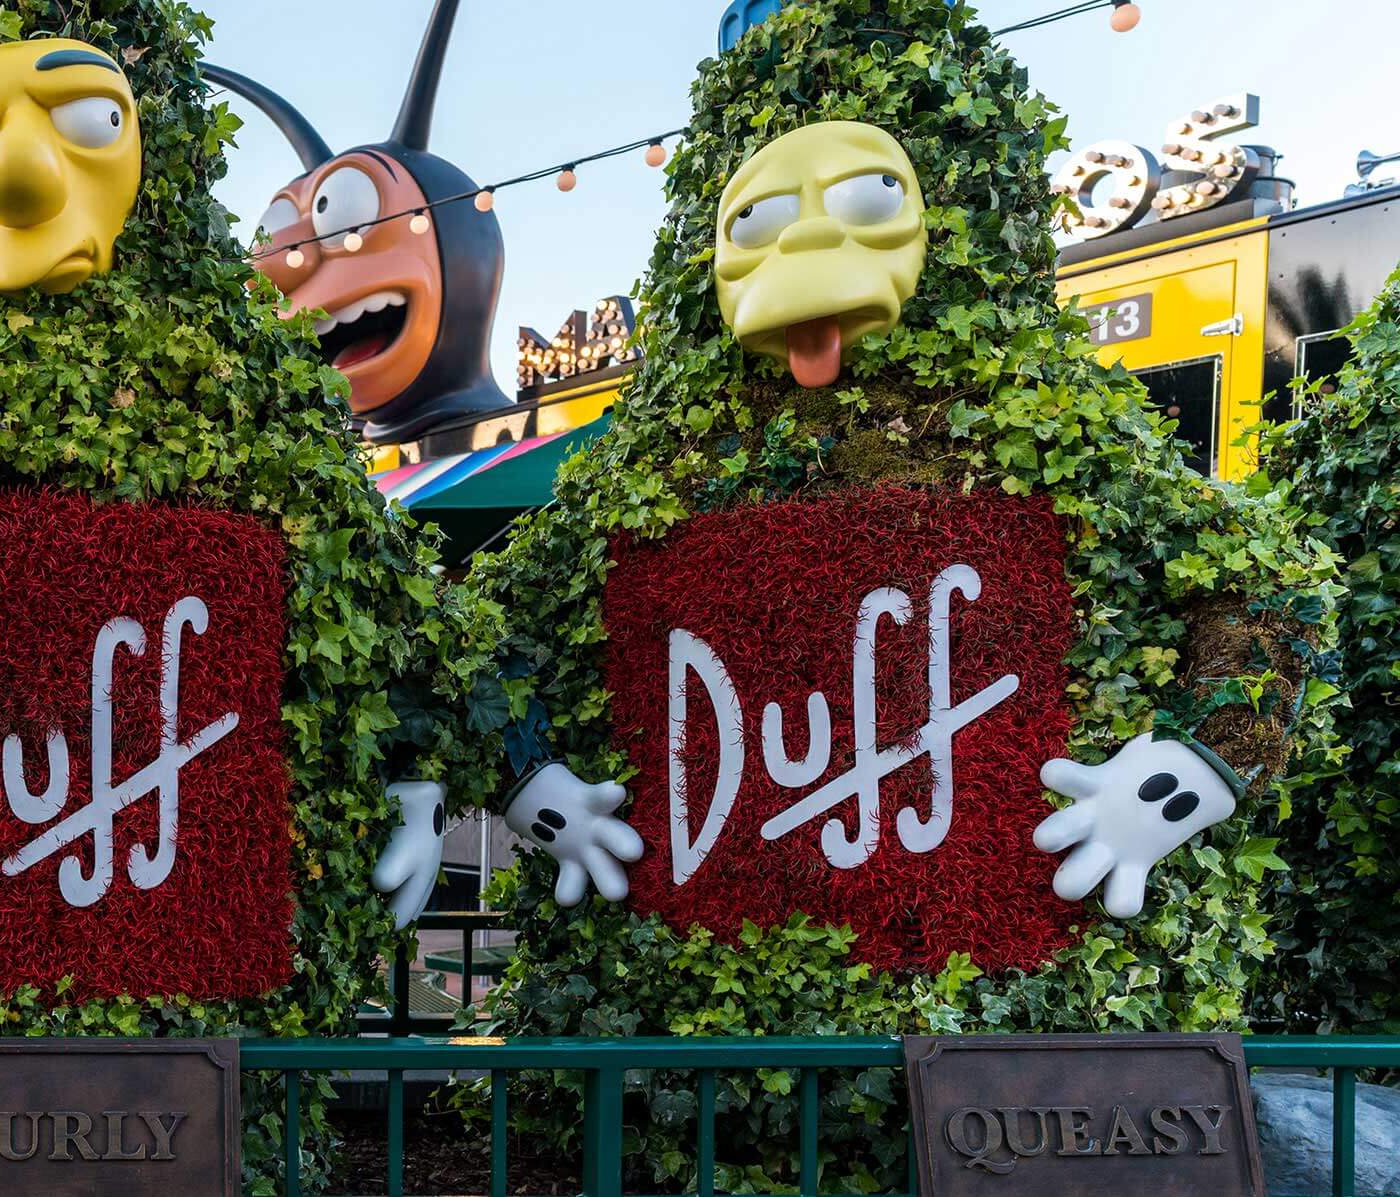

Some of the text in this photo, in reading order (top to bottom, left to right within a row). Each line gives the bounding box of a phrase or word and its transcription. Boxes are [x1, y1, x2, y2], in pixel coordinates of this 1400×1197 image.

[1072, 300, 1140, 341] 13
[668, 563, 1020, 886] Duff
[944, 1104, 1232, 1175] QUEASY
